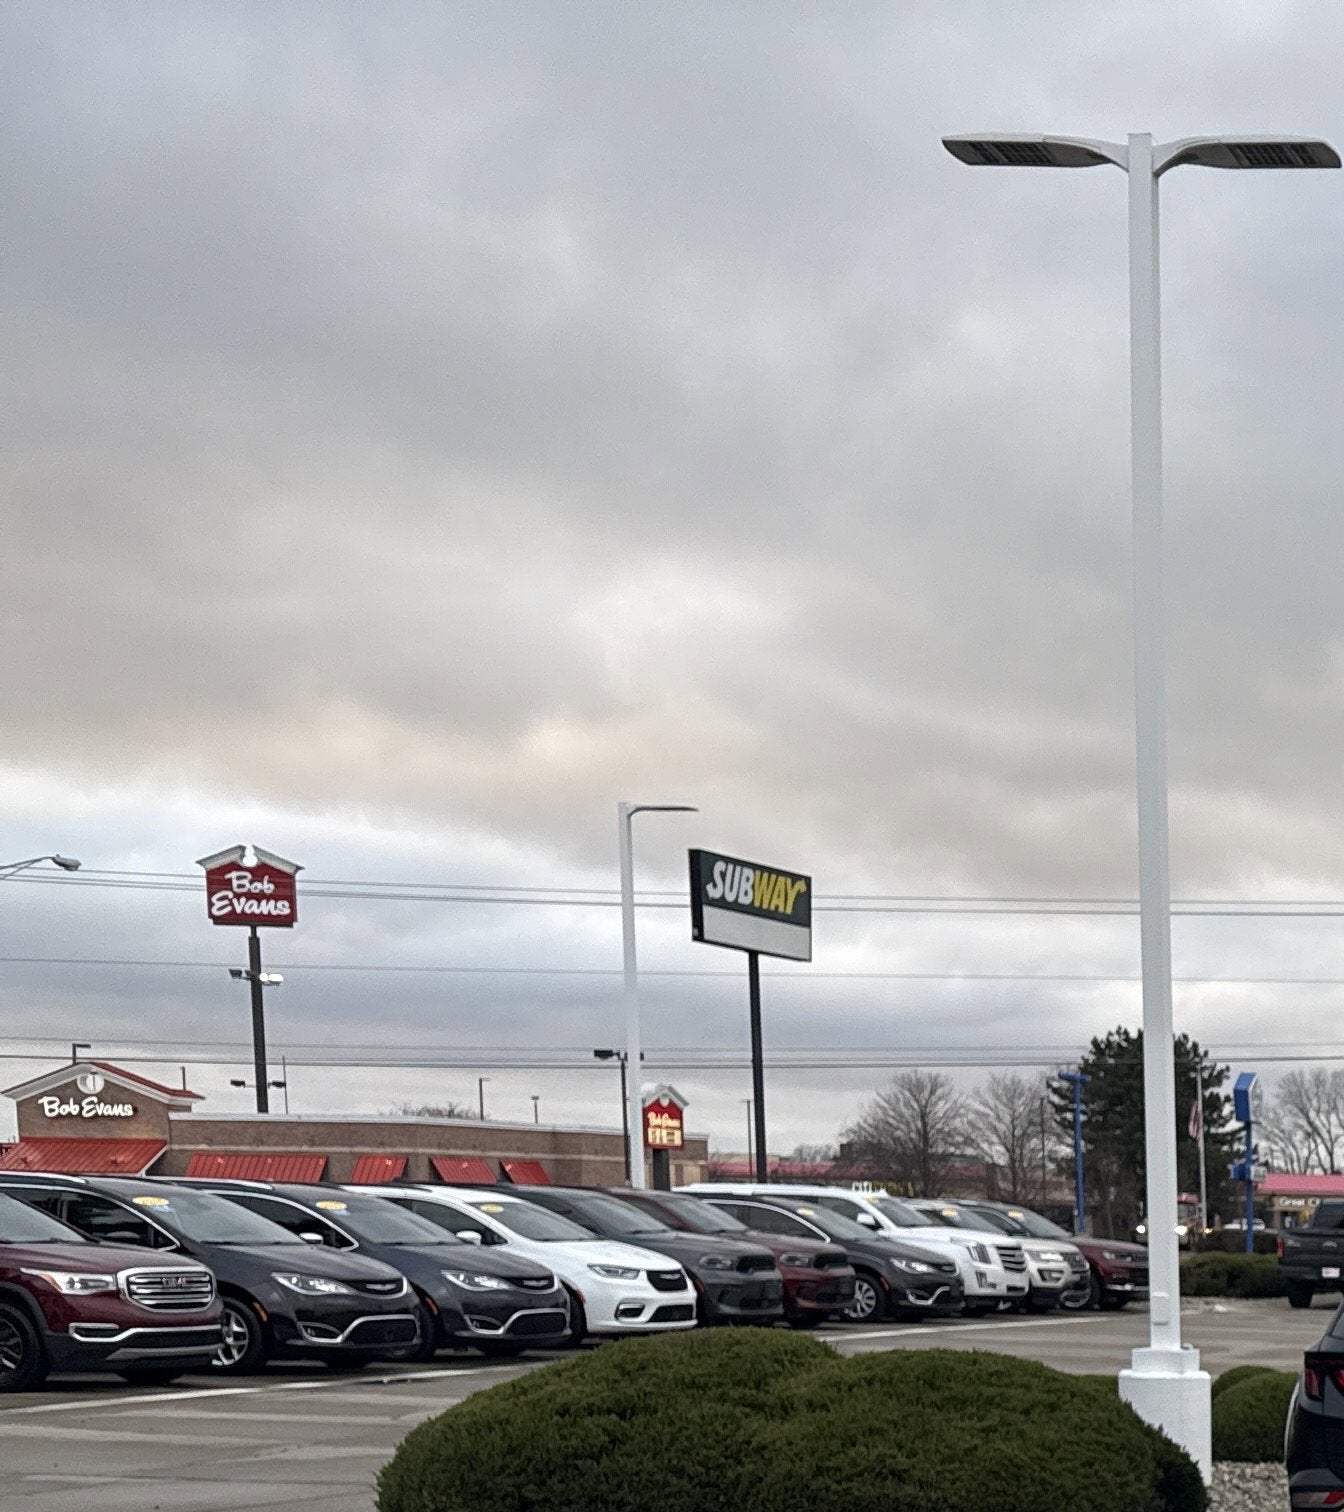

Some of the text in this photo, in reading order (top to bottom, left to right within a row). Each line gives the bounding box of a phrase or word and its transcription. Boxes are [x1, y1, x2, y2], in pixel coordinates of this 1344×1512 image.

[224, 870, 275, 894] Bob
[706, 860, 807, 915] SUBWAY
[211, 890, 291, 917] Evans
[38, 1096, 134, 1118] Bob Evans
